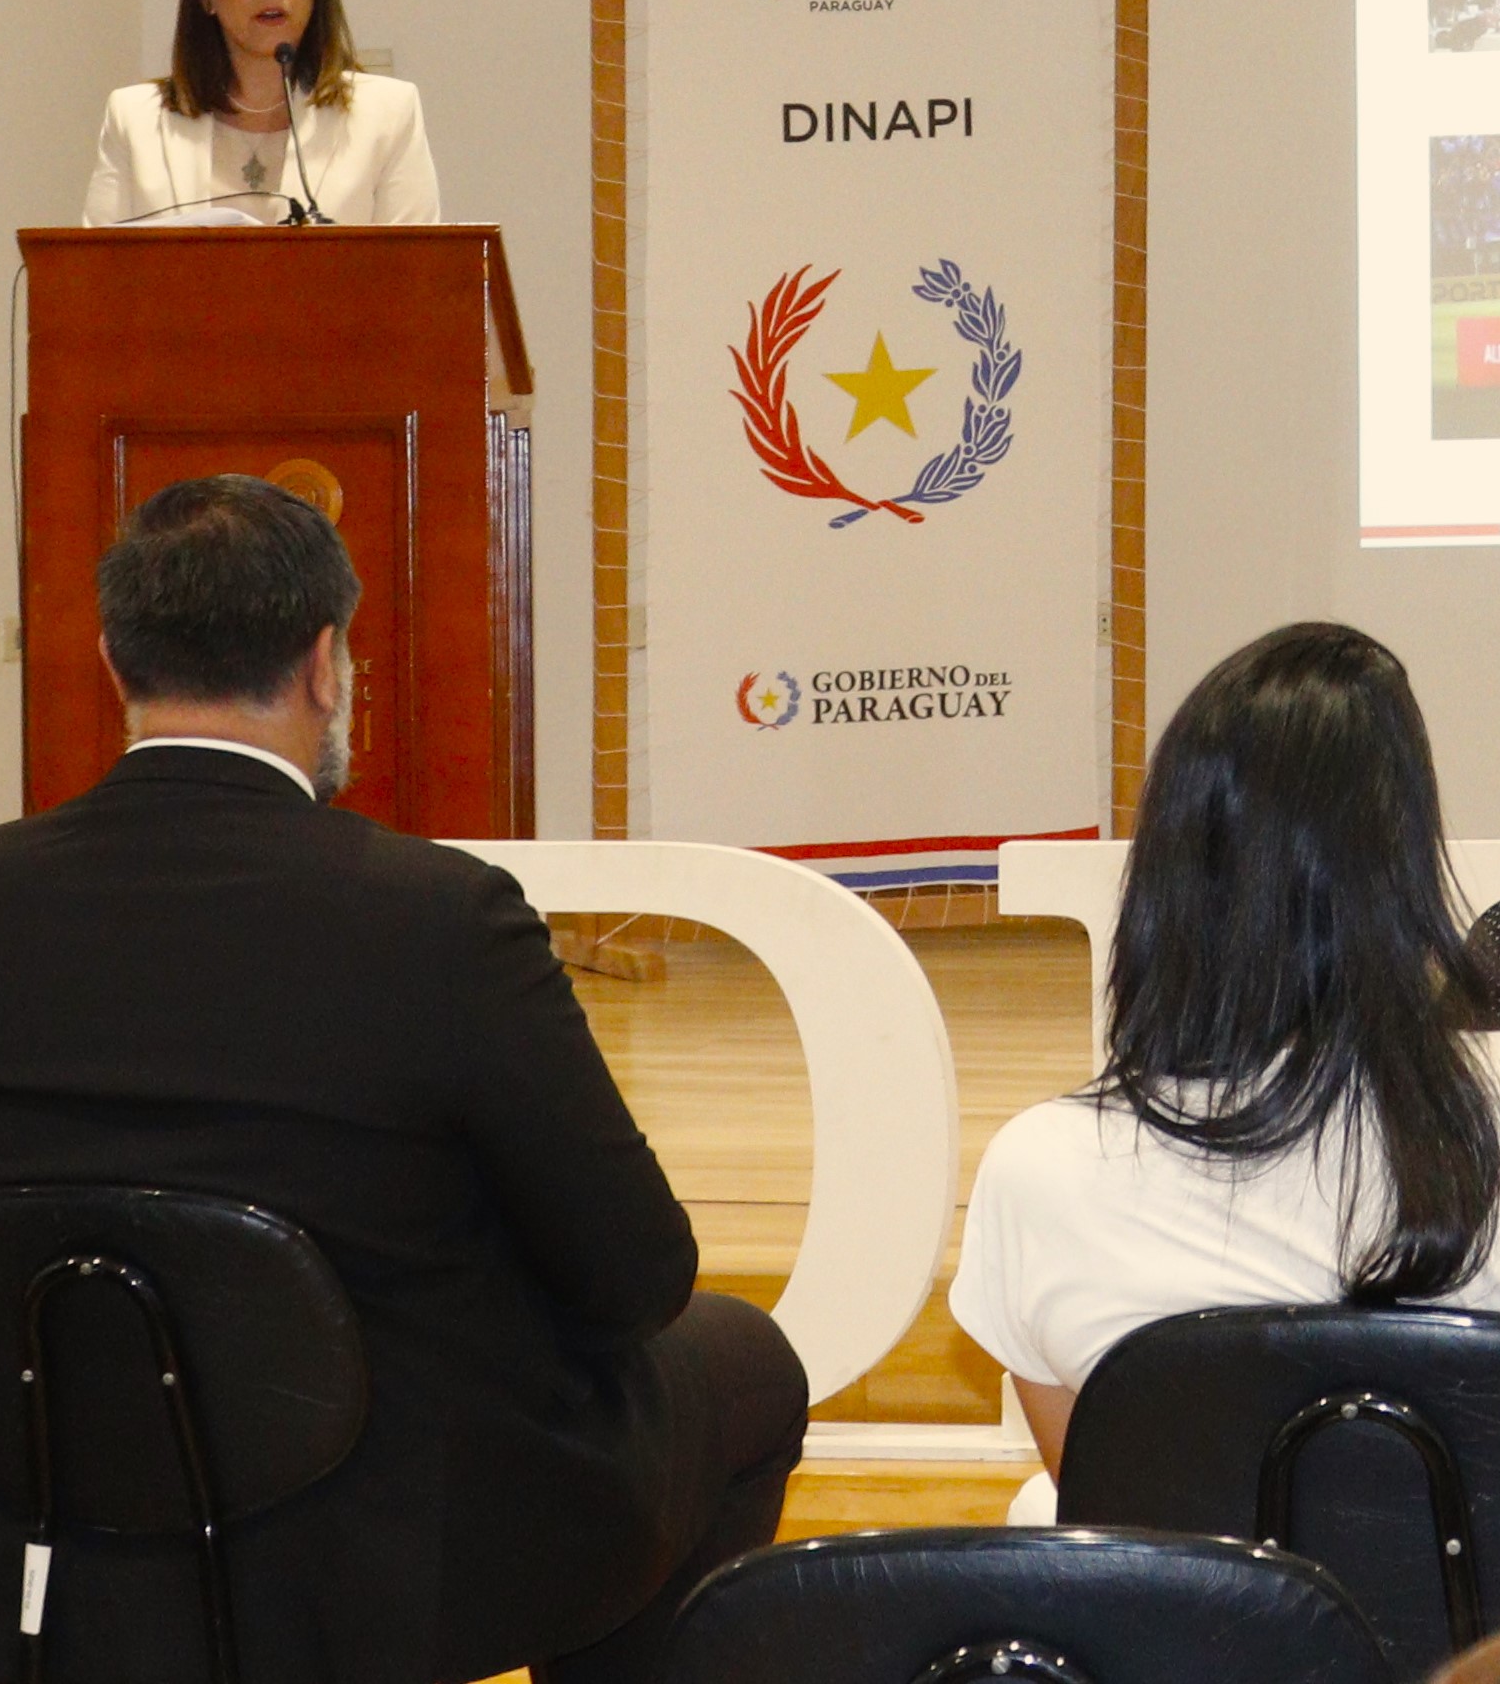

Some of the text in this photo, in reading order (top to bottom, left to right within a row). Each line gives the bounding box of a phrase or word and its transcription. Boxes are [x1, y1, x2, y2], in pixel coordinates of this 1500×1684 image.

[810, 0, 894, 12] PARAGUAY
[783, 97, 972, 143] DINAPI
[812, 665, 1012, 693] GOBIERNO DEL
[812, 690, 1011, 724] PARAGUAY
